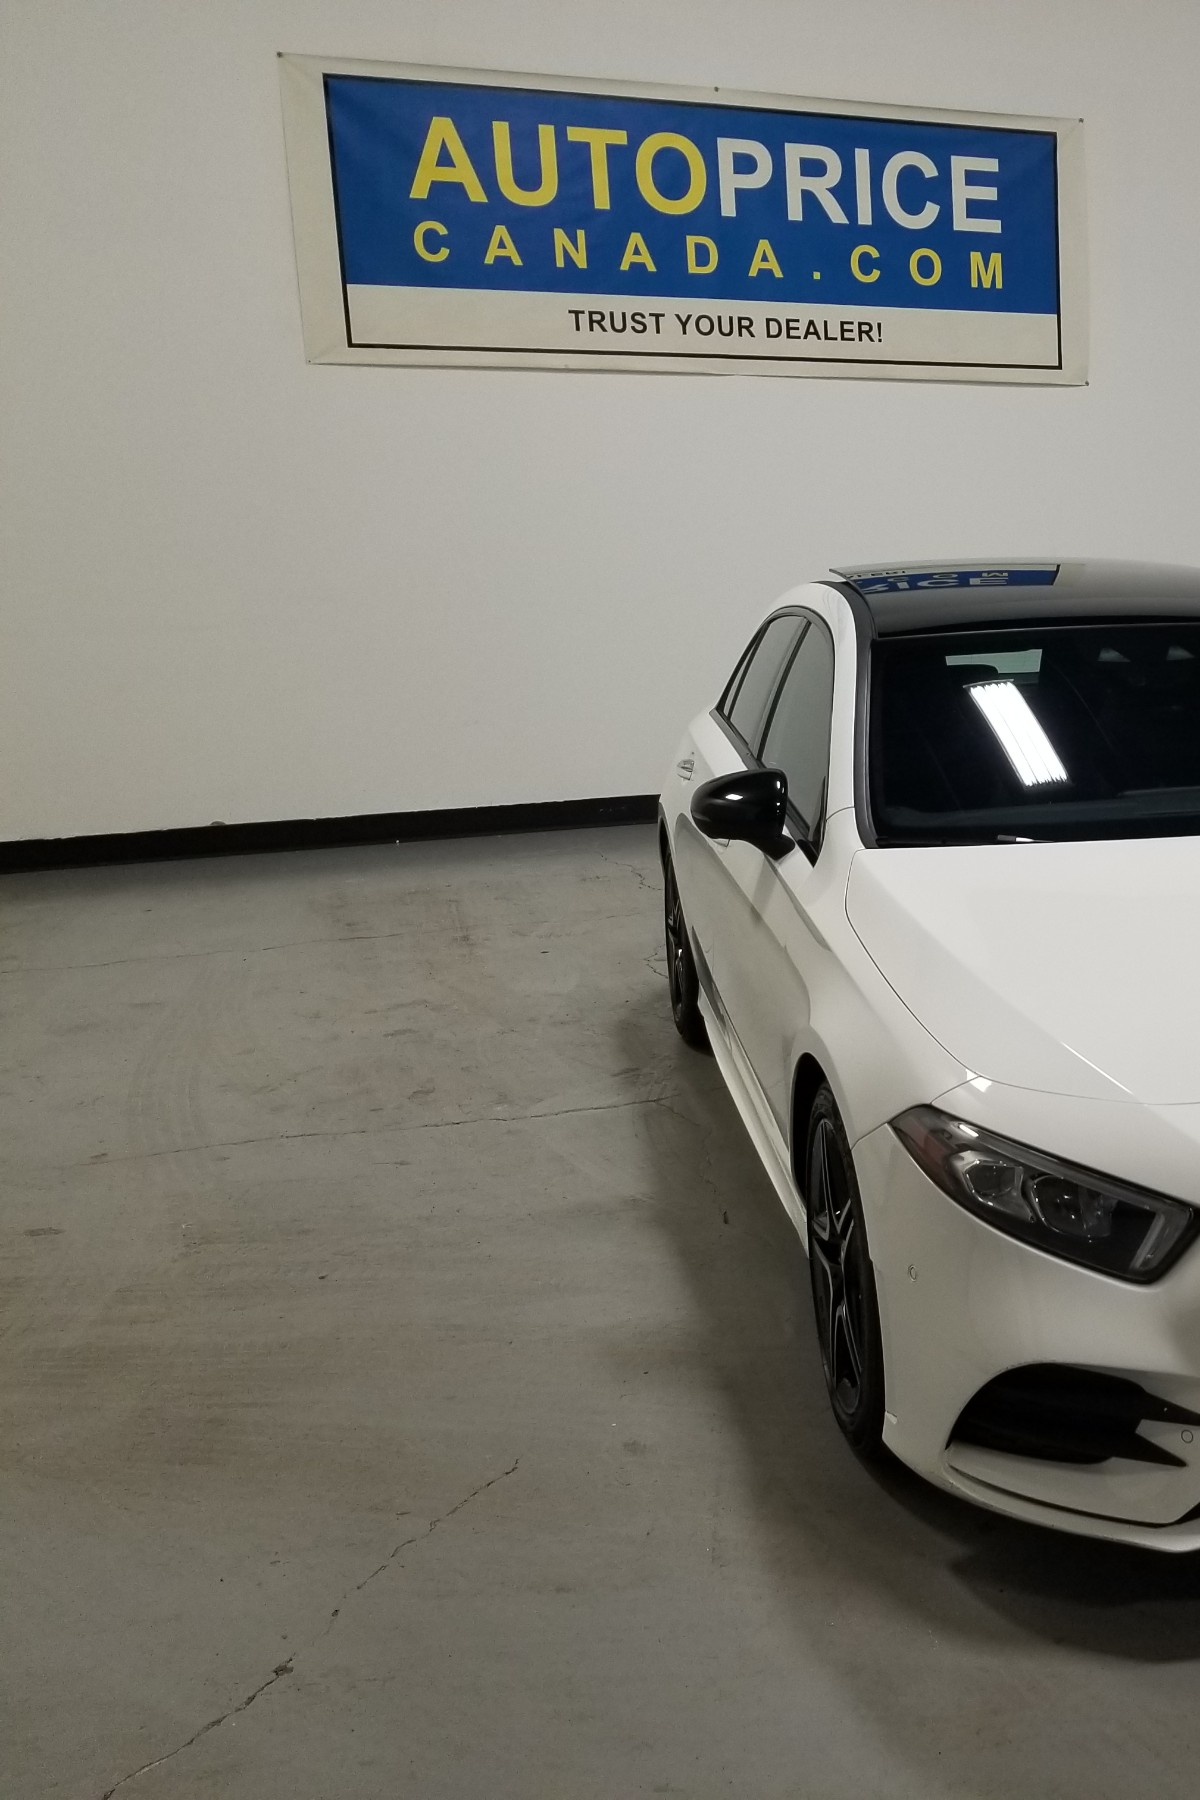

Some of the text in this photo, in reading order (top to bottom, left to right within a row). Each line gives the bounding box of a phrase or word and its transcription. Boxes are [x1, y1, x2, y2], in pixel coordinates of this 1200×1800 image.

[409, 116, 1002, 234] AUTOPRICE
[567, 309, 883, 343] TRUST YOUR DEALER!
